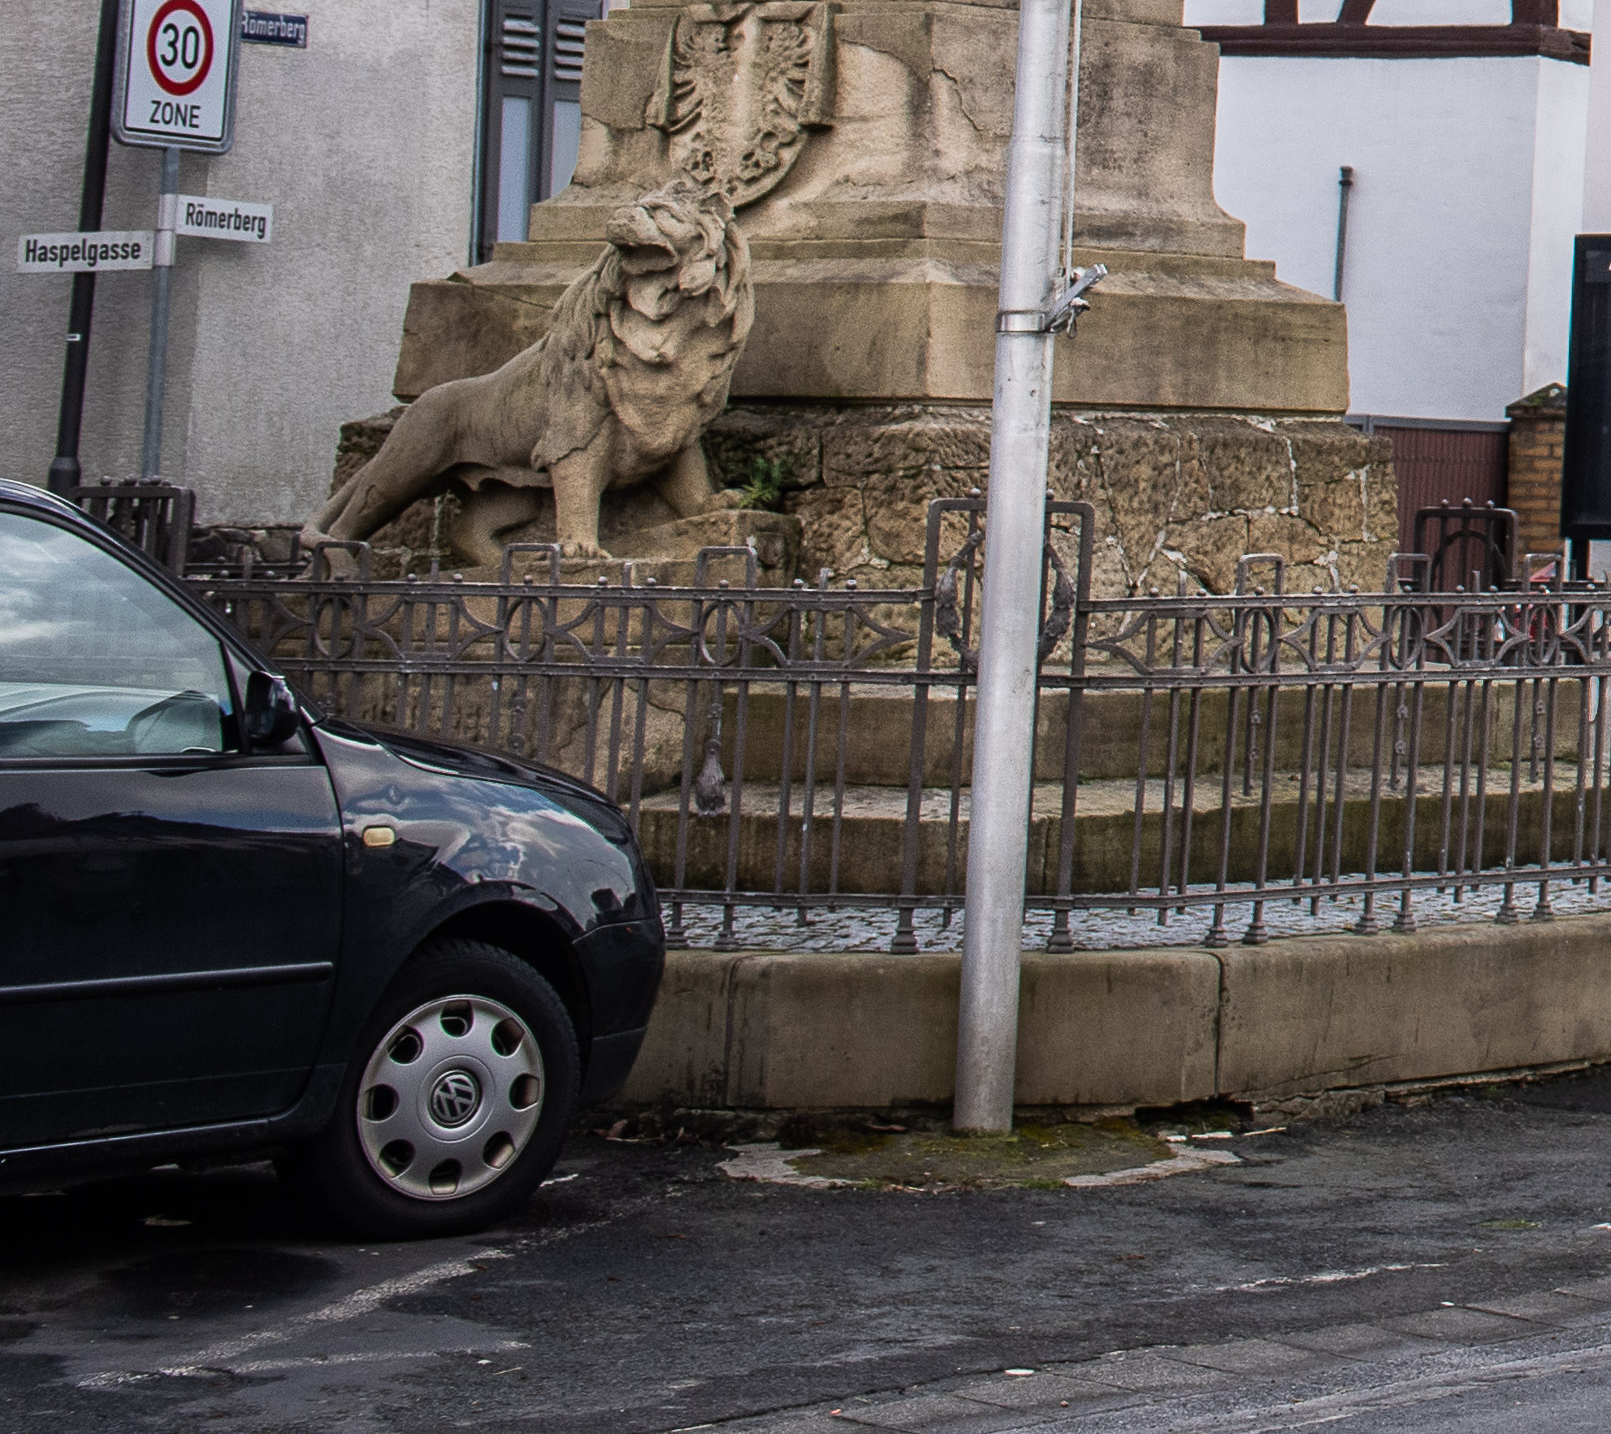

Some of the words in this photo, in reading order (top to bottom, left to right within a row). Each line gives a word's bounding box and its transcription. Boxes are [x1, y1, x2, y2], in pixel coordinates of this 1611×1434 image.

[160, 22, 200, 69] 30
[150, 100, 201, 128] ZONE
[185, 202, 267, 240] Römerberg
[25, 238, 141, 267] Haspelgasse
